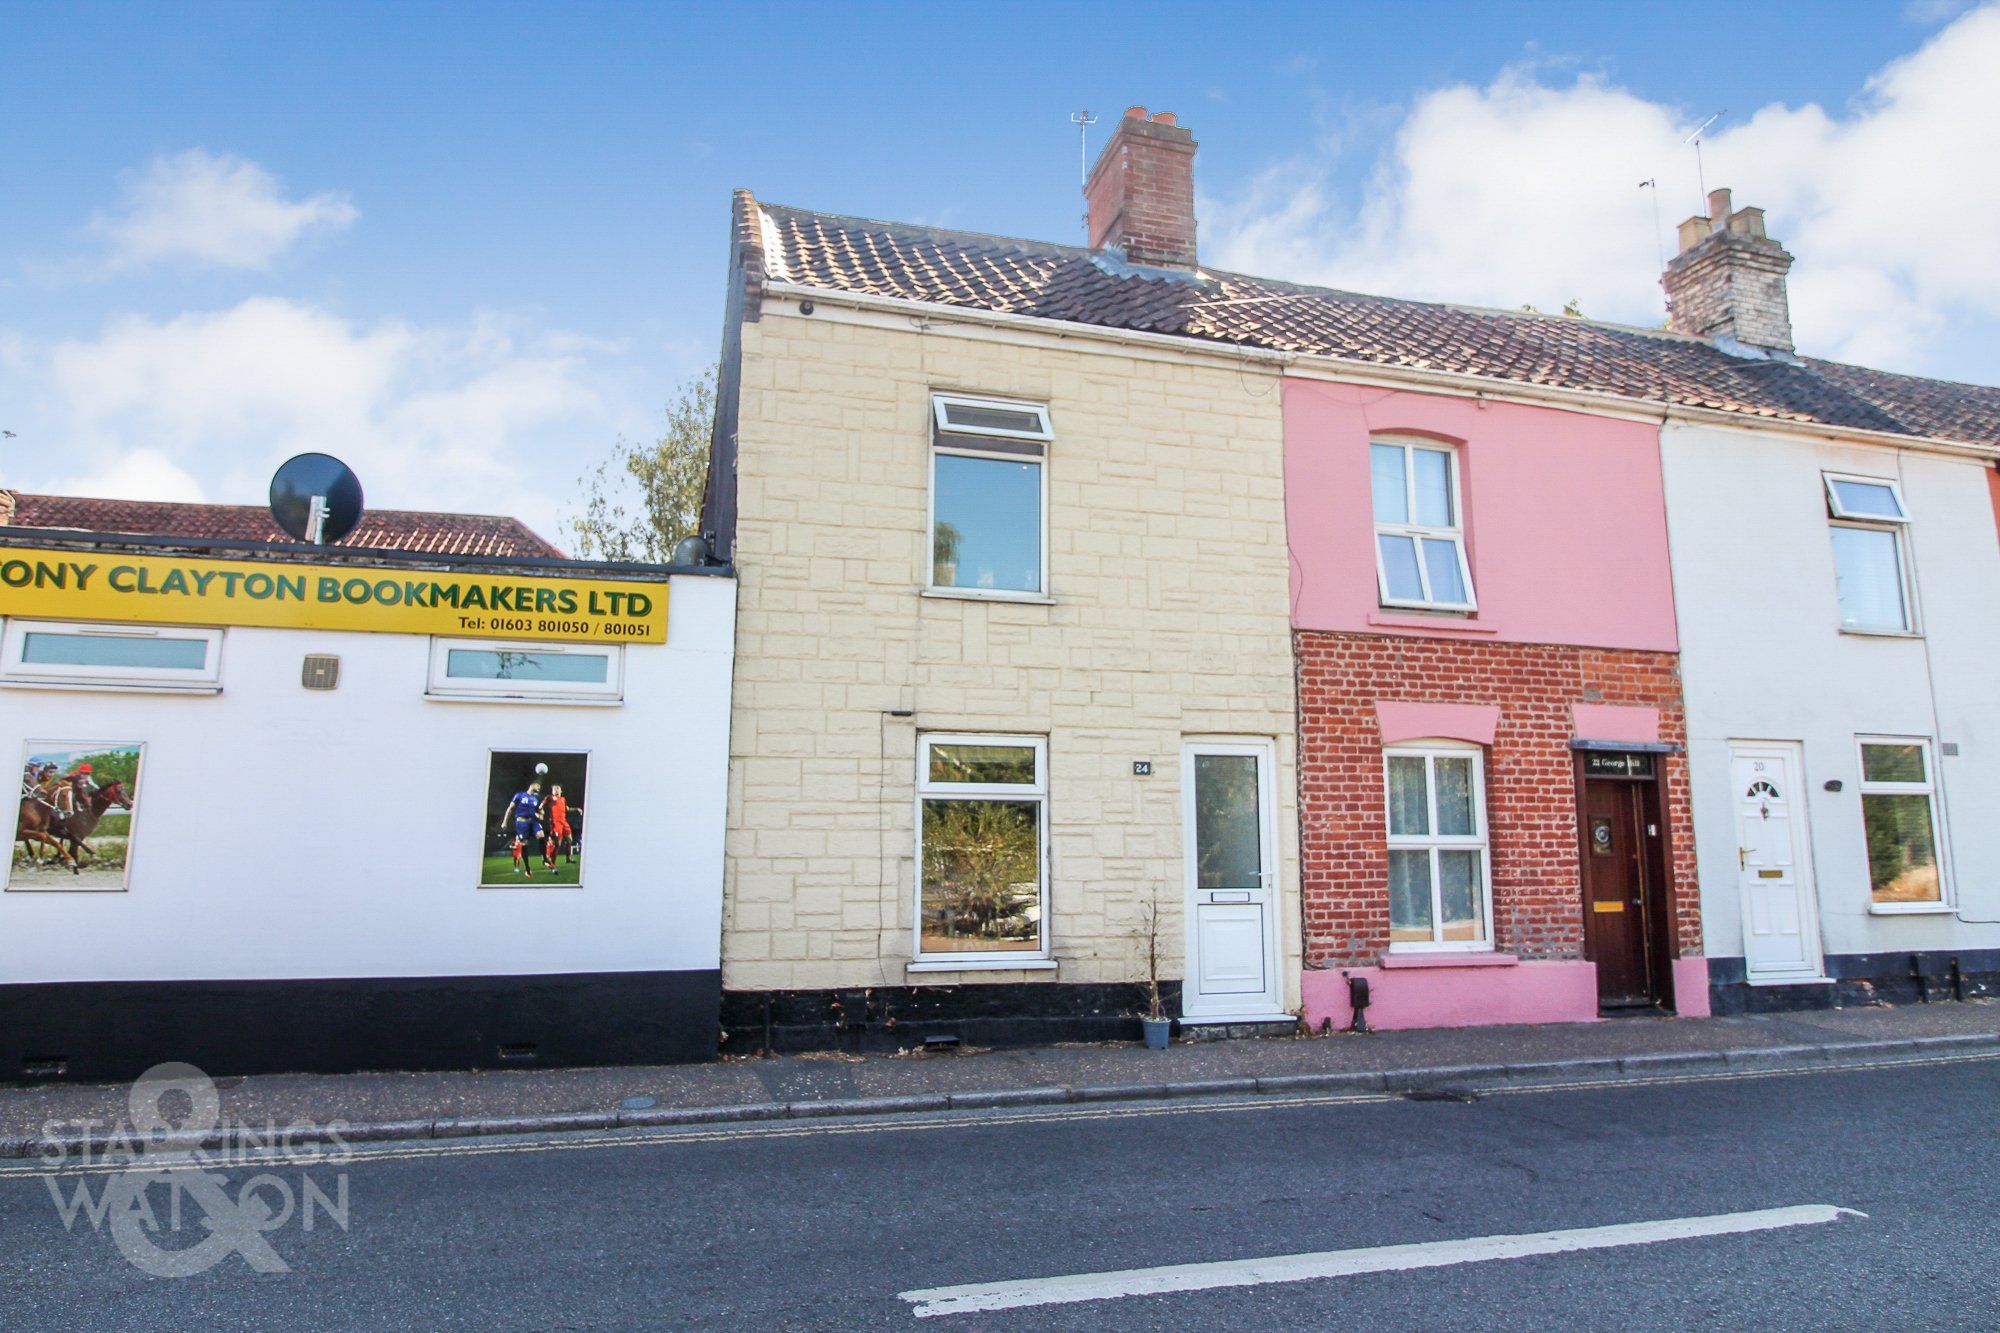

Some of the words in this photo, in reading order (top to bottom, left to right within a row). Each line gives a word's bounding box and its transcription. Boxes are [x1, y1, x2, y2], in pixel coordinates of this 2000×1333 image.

[0, 559, 98, 590] ONY
[108, 565, 306, 601] CLAYTON
[317, 577, 579, 613] BOOKMAKERS
[588, 590, 653, 616] LTD
[458, 616, 486, 630] Tel:
[490, 618, 532, 631] 01603
[538, 621, 589, 634] 801050
[604, 623, 650, 636] 801051
[1135, 763, 1148, 773] 24
[1753, 760, 1764, 771] 20
